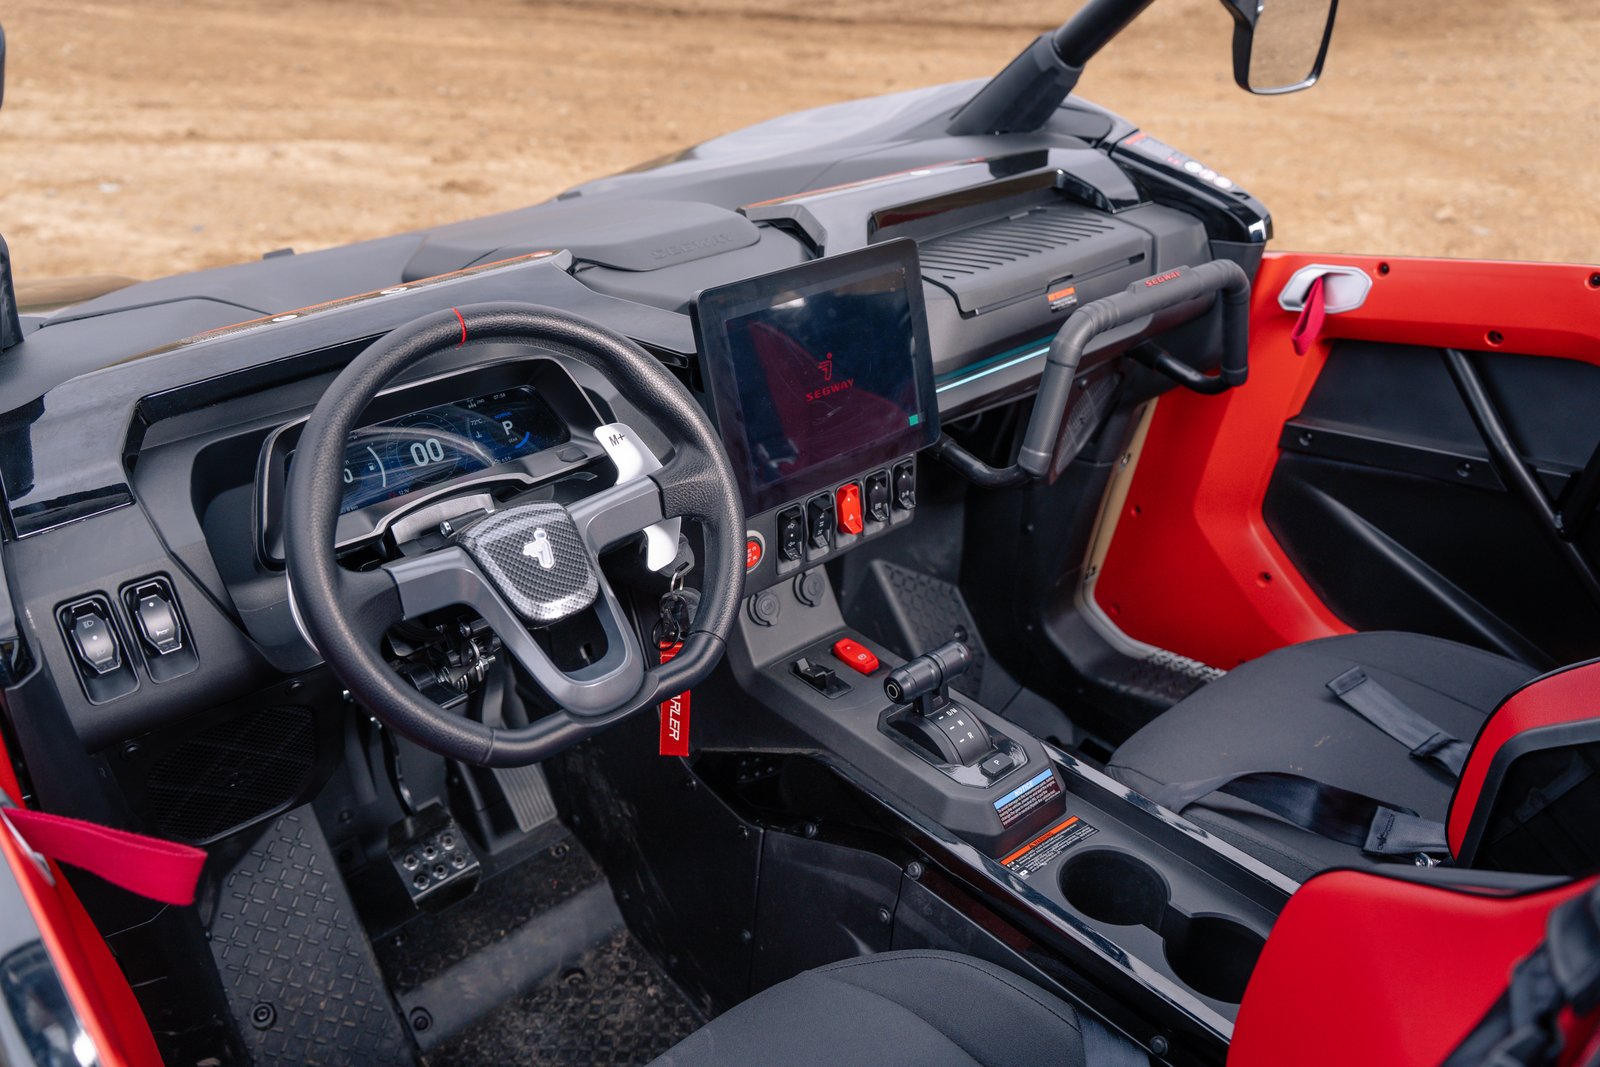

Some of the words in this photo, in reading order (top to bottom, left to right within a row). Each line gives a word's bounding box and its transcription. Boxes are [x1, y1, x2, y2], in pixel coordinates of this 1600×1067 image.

[1145, 271, 1181, 287] SEGWAY
[805, 377, 855, 402] SEGWAY
[502, 420, 513, 436] P
[609, 433, 625, 447] M+
[410, 438, 445, 467] 00
[957, 719, 964, 727] N
[967, 731, 975, 740] R
[1014, 779, 1034, 796] NOTICE
